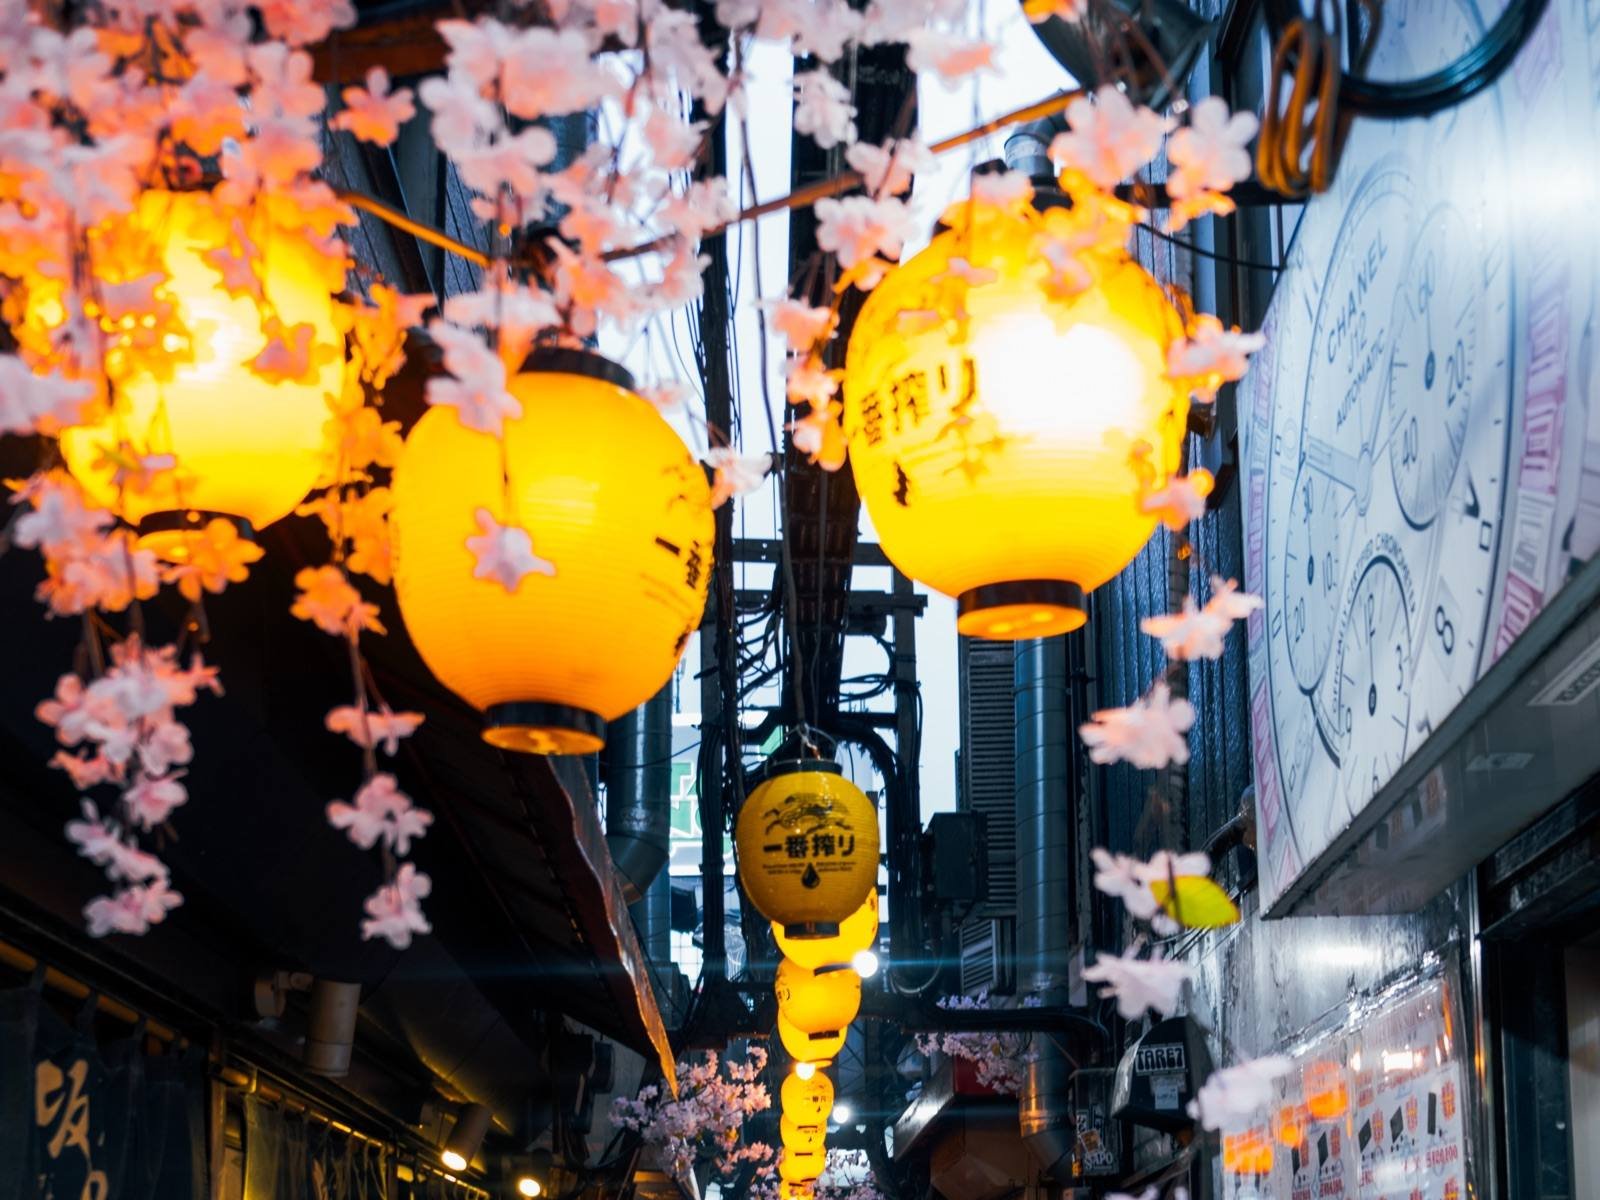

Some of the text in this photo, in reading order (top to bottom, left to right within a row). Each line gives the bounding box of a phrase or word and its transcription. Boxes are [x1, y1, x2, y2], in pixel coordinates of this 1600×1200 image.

[1328, 228, 1387, 364] CHANEL
[1336, 328, 1384, 433] AUTOMATIC
[1435, 605, 1465, 655] 8
[763, 834, 855, 858] 一番搾り
